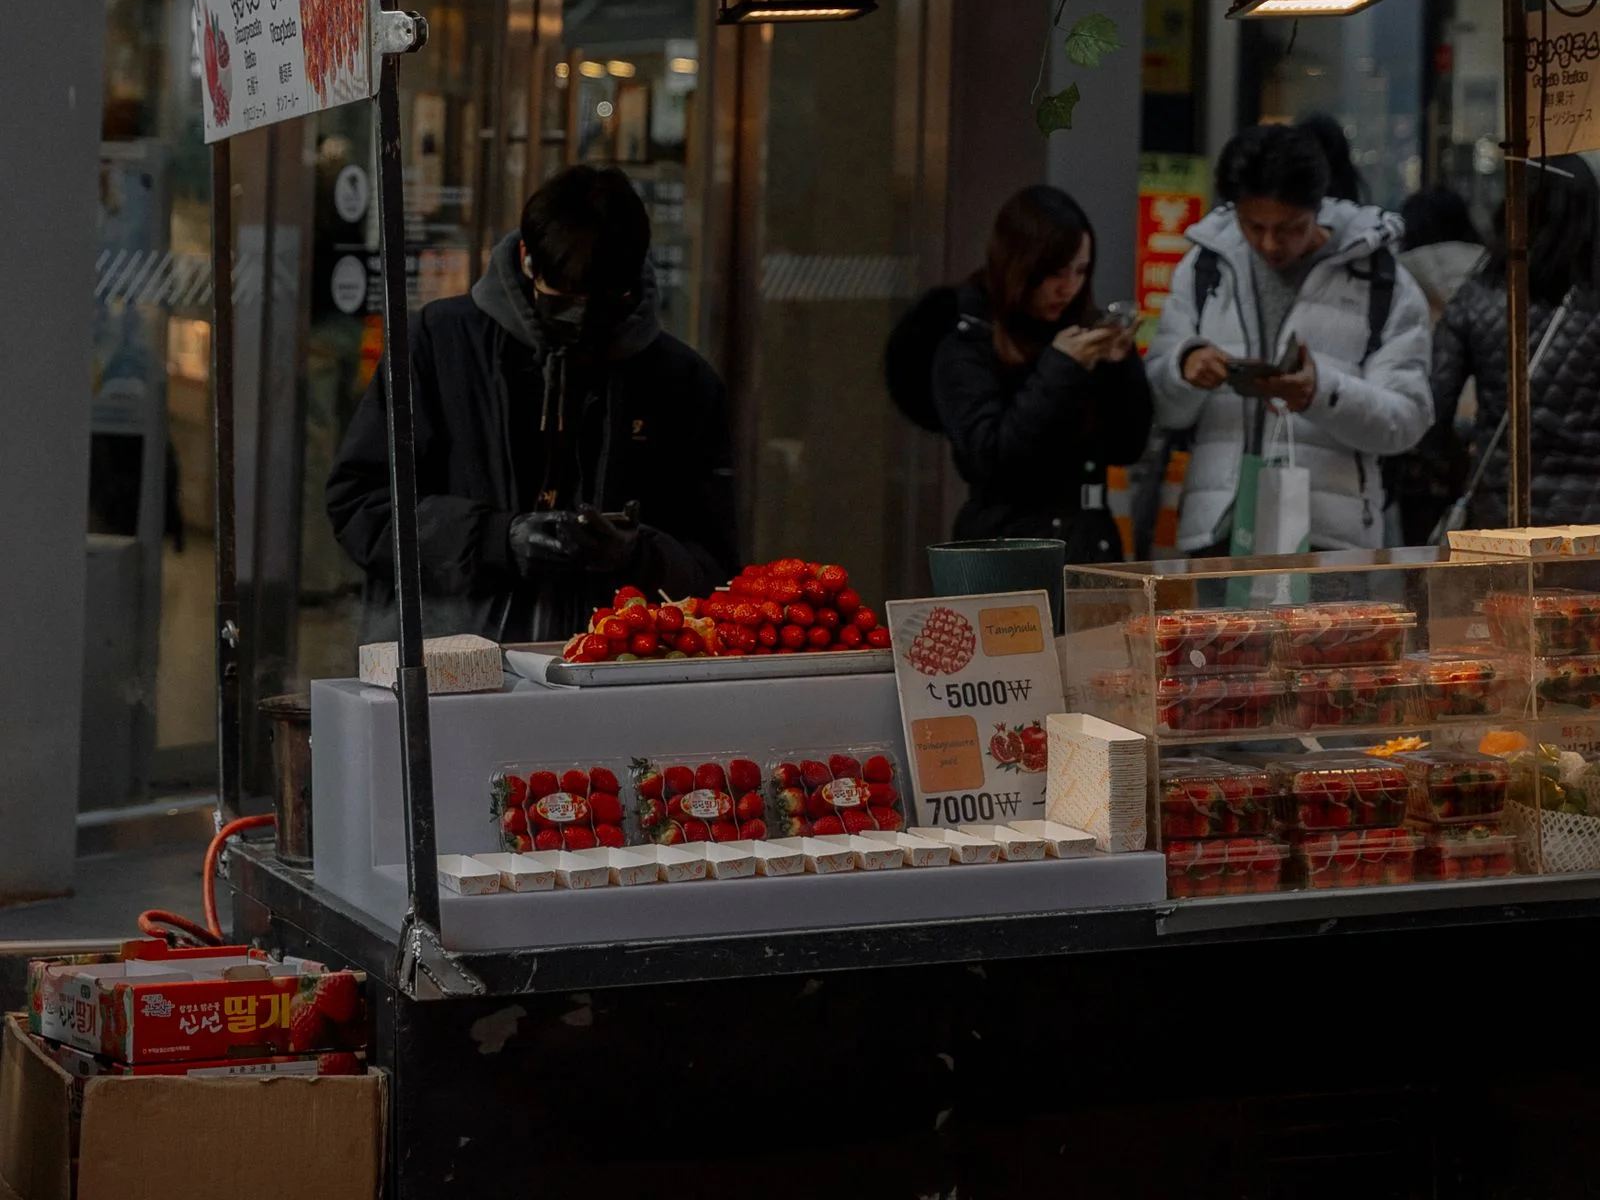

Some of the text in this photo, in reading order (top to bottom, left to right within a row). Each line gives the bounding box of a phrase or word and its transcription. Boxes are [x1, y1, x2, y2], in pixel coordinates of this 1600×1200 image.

[1528, 108, 1593, 128] フーツジュース
[76, 1000, 96, 1036] 딸기
[179, 993, 290, 1035] 신선 딸기
